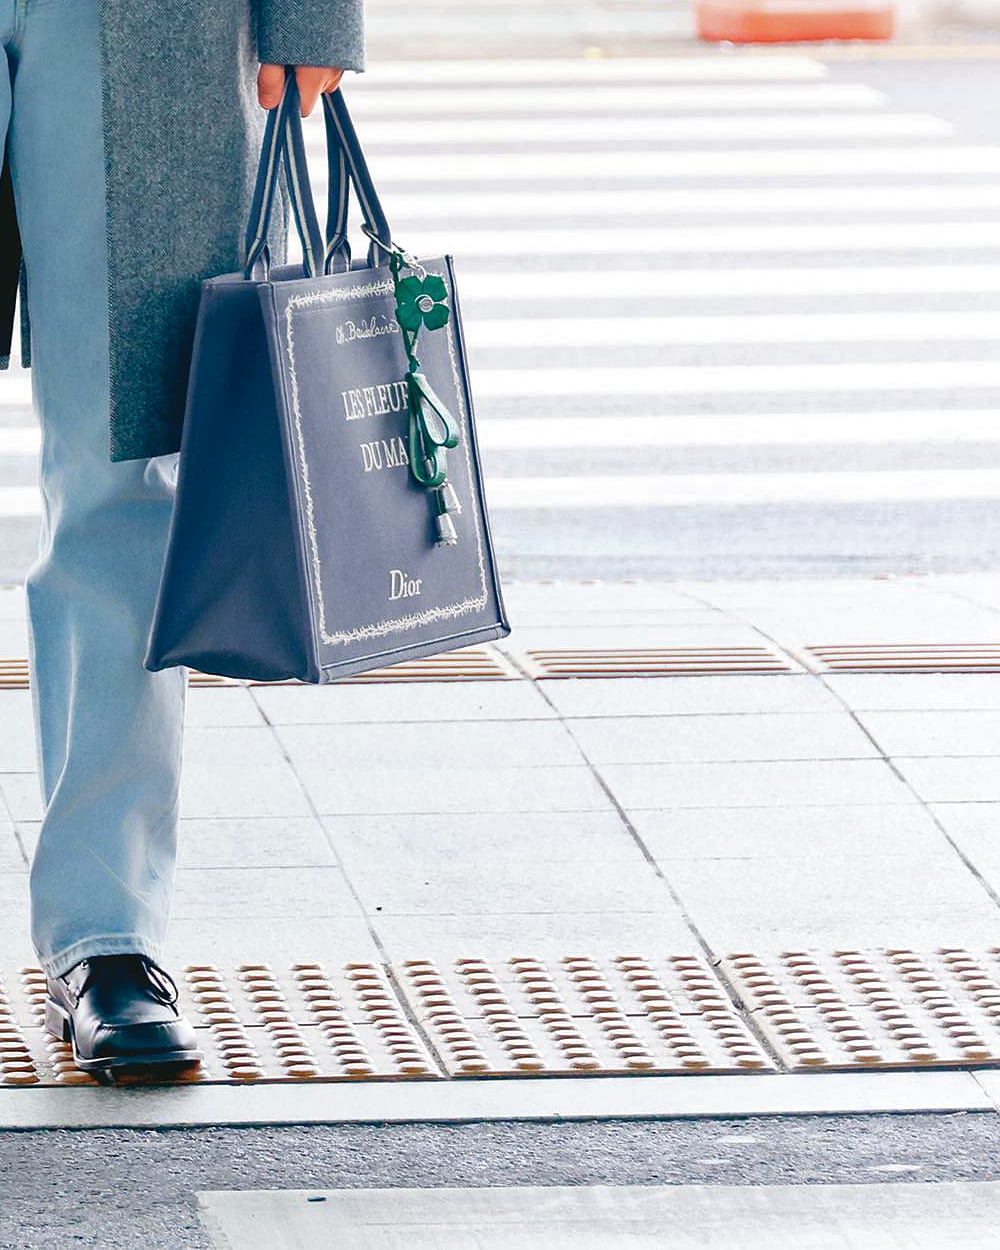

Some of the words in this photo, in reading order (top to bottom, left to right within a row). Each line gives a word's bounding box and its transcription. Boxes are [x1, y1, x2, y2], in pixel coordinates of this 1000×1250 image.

[341, 389, 365, 421] LES
[363, 381, 409, 417] FLEUR
[360, 441, 382, 472] DU
[382, 436, 410, 468] MA
[388, 569, 423, 600] Dior
